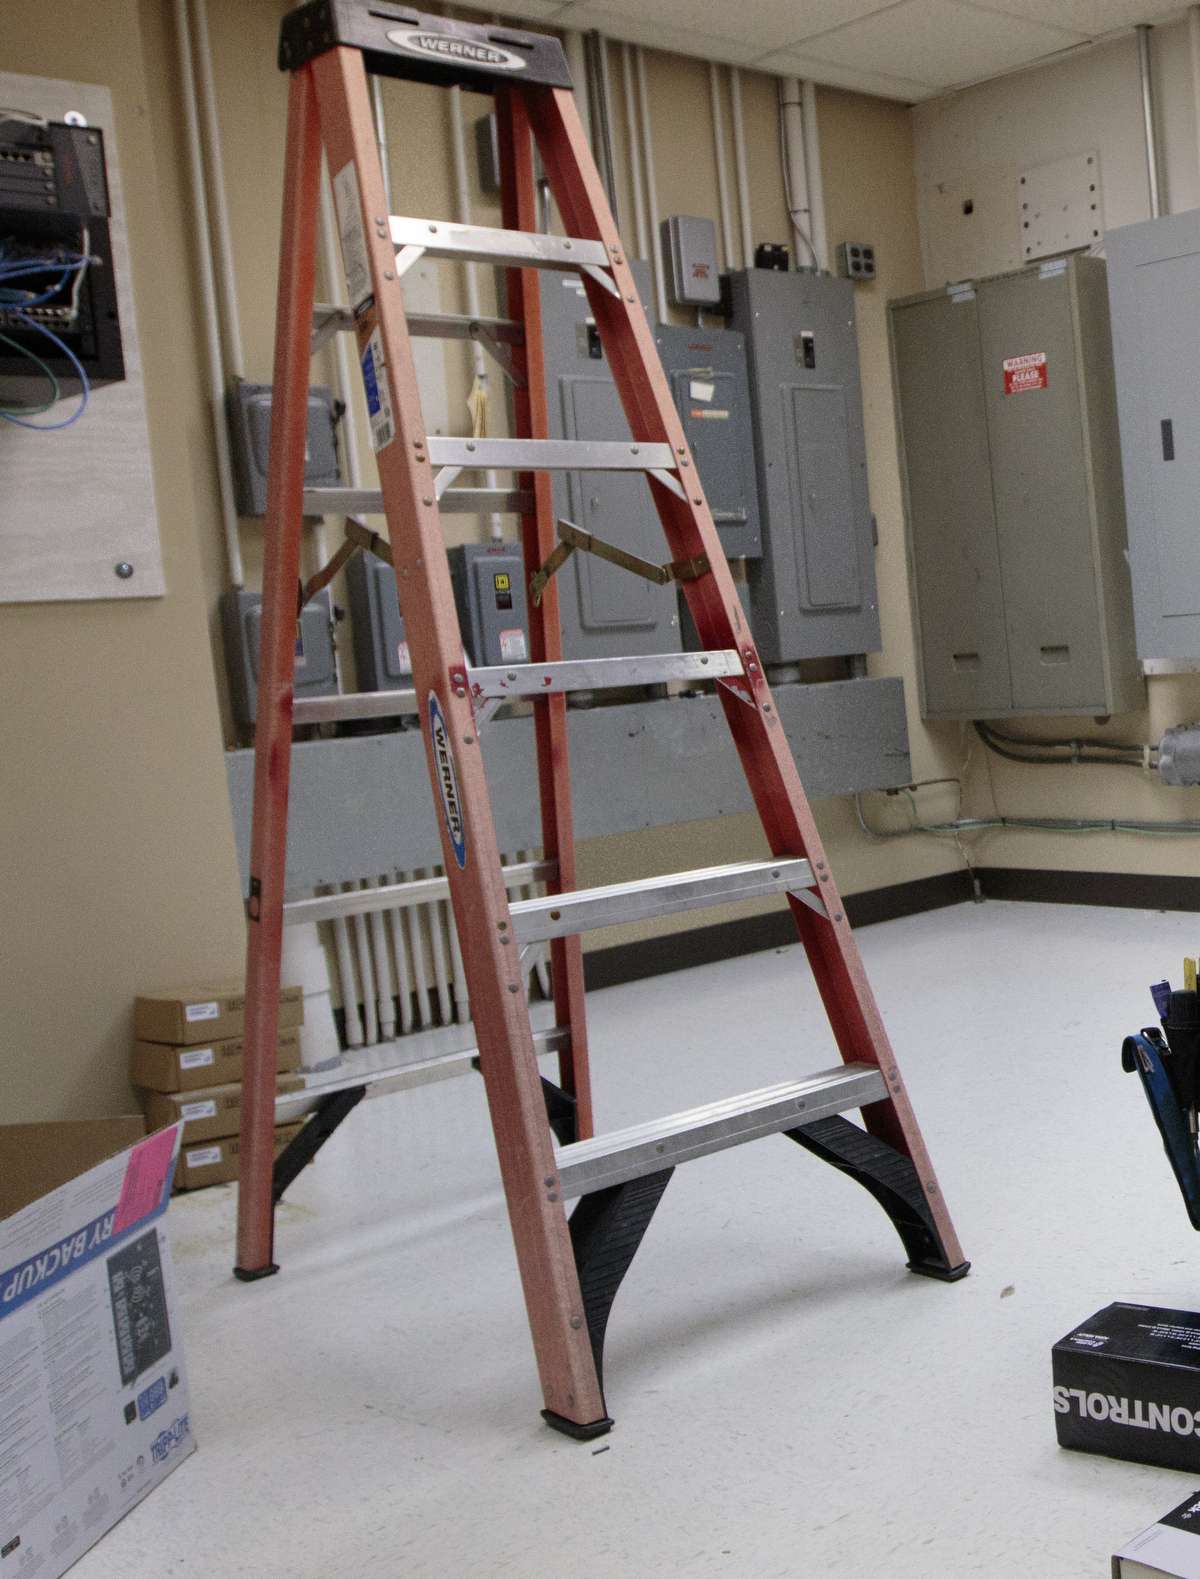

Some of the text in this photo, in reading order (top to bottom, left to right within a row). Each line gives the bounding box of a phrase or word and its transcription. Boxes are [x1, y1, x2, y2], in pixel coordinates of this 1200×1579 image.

[419, 36, 501, 63] WERNER
[1007, 354, 1042, 367] WARNING
[1012, 370, 1039, 382] PLEASE
[434, 727, 461, 833] WERNER
[3, 1230, 88, 1303] BACKUP
